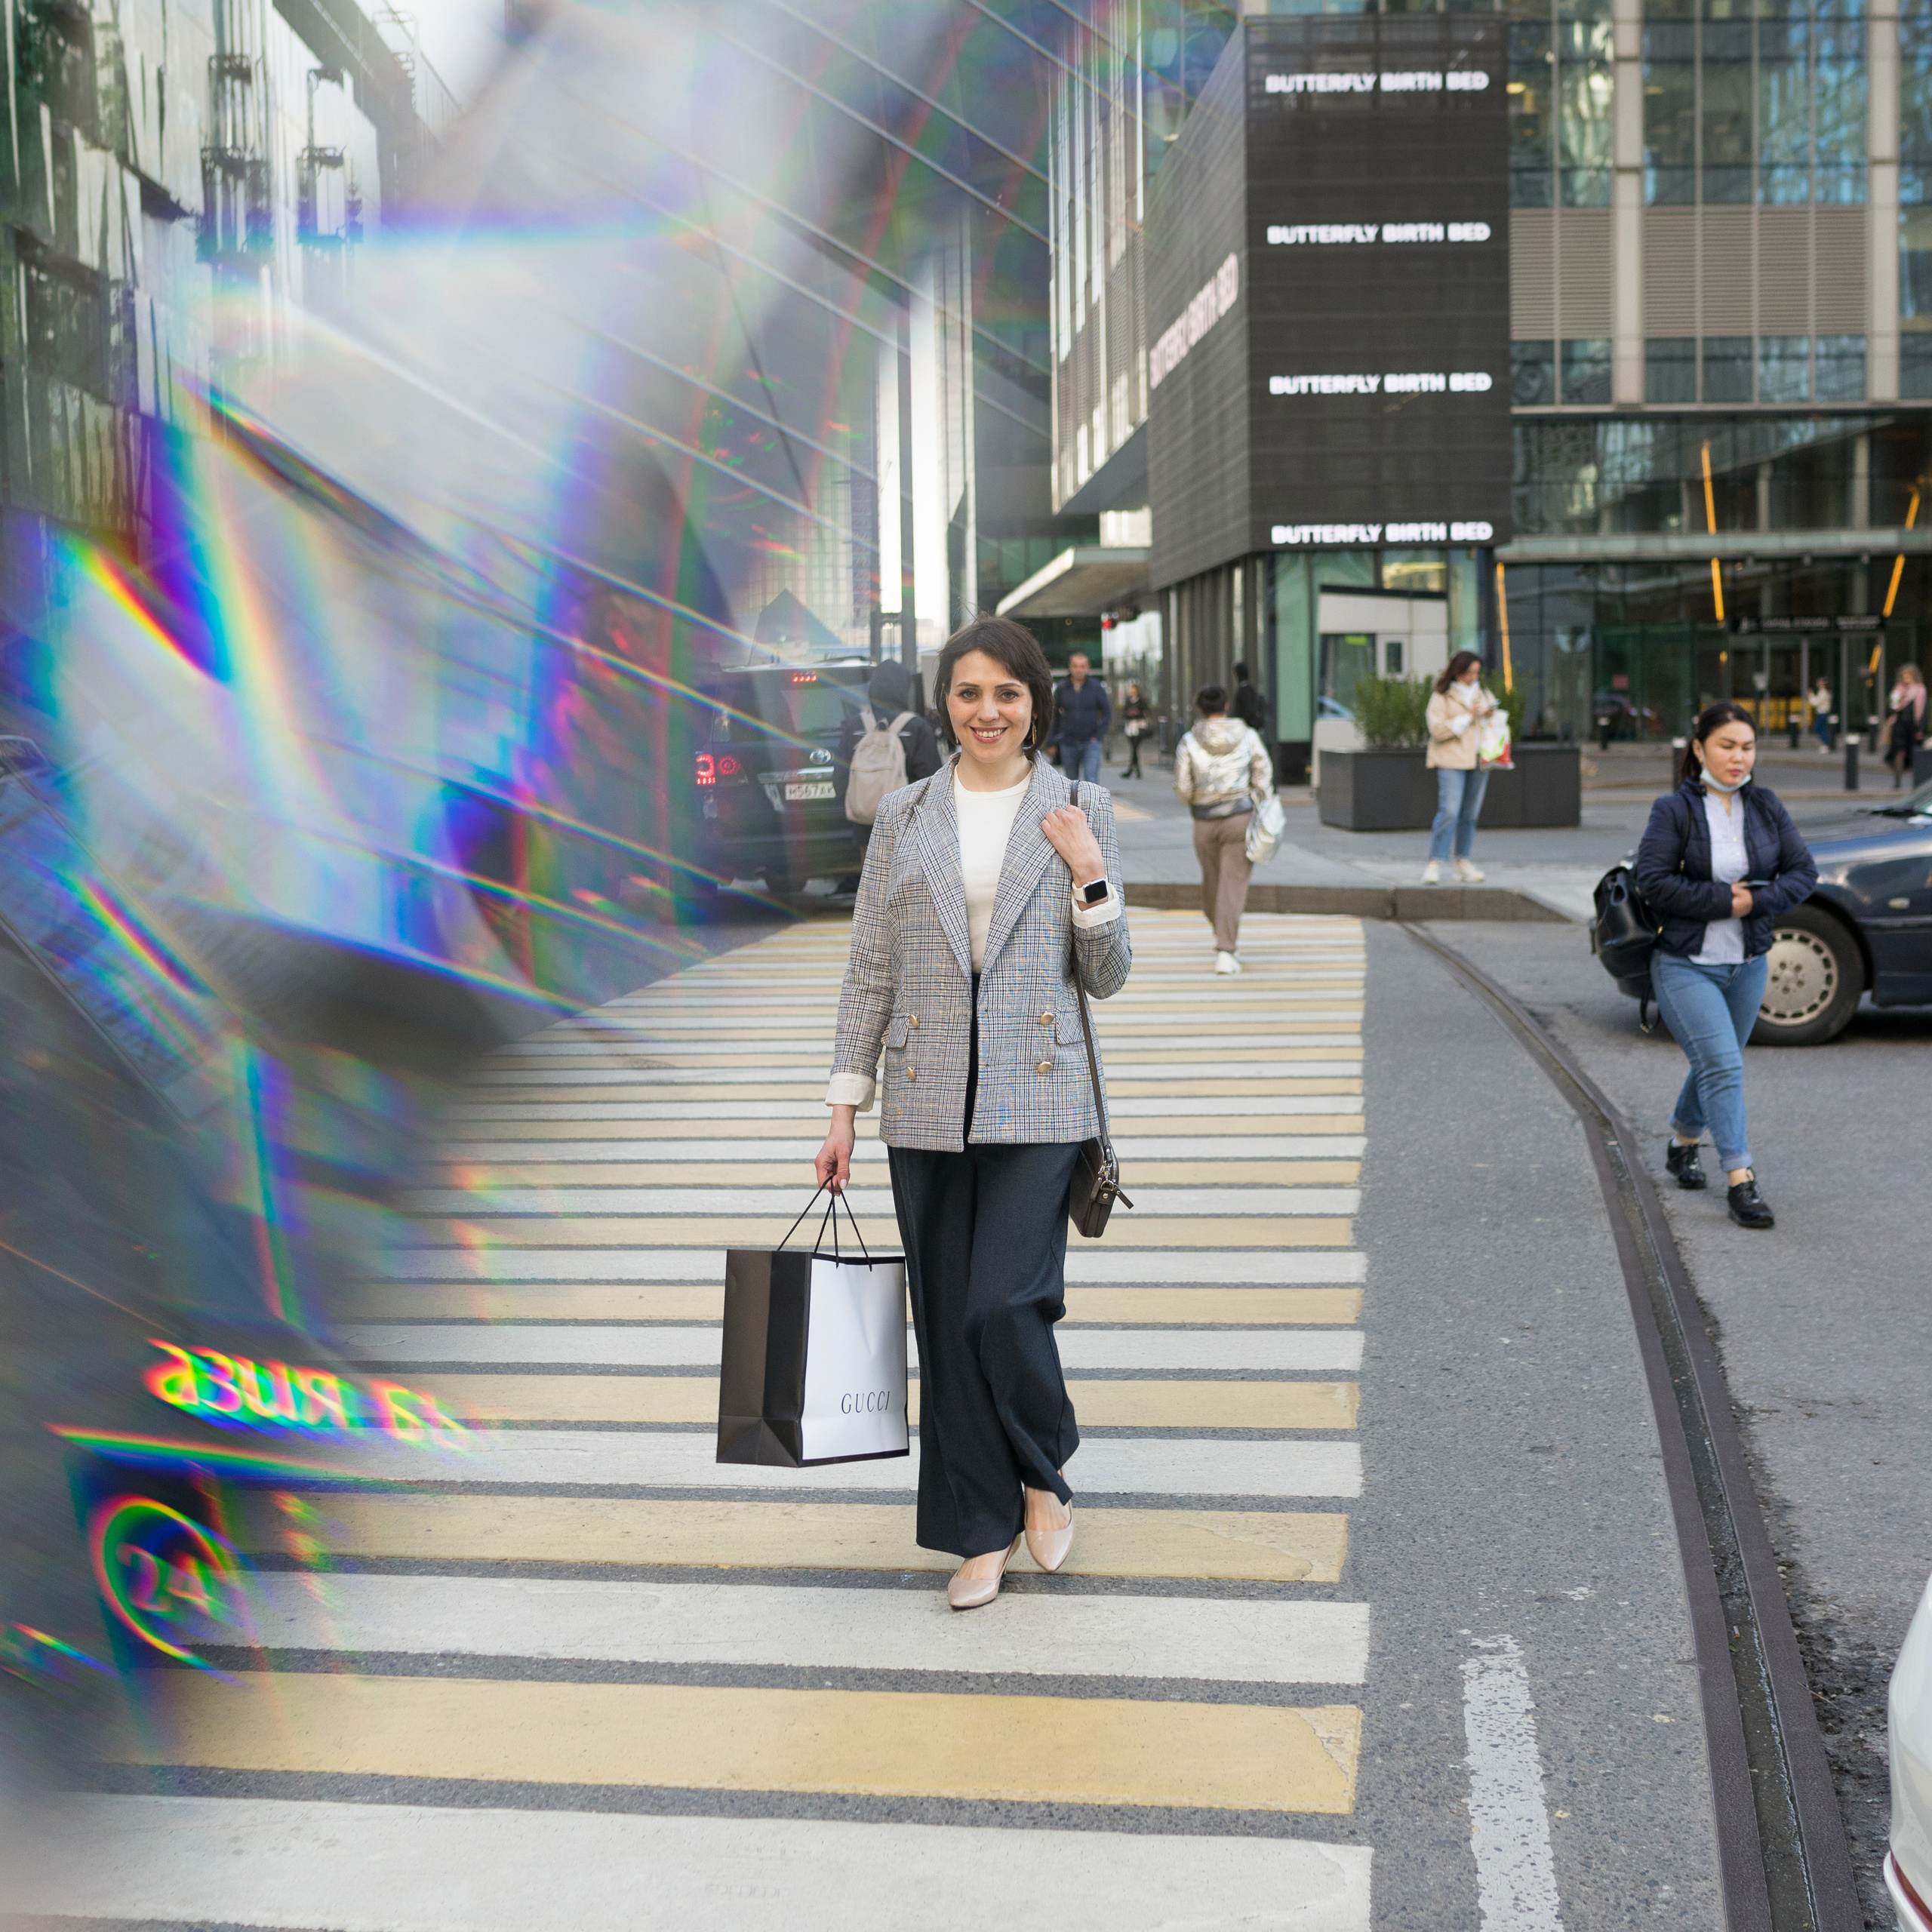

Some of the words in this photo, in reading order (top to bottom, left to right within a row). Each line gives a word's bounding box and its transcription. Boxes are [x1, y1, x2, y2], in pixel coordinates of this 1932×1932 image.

[1265, 72, 1377, 93] BUTTERFLY
[1380, 72, 1442, 91] BIRTH
[1446, 71, 1489, 91] BED
[1266, 224, 1379, 245] BUTTERFLY
[1382, 223, 1444, 243] BIRTH
[1447, 222, 1491, 242] BED
[1269, 374, 1381, 395] BUTTERFLY
[1383, 373, 1446, 393] BIRTH
[1449, 372, 1492, 392] BED
[1271, 524, 1383, 544] BUTTERFLY
[1385, 522, 1447, 543] BIRTH
[1450, 521, 1493, 541] BED
[841, 1391, 890, 1414] GUCCI
